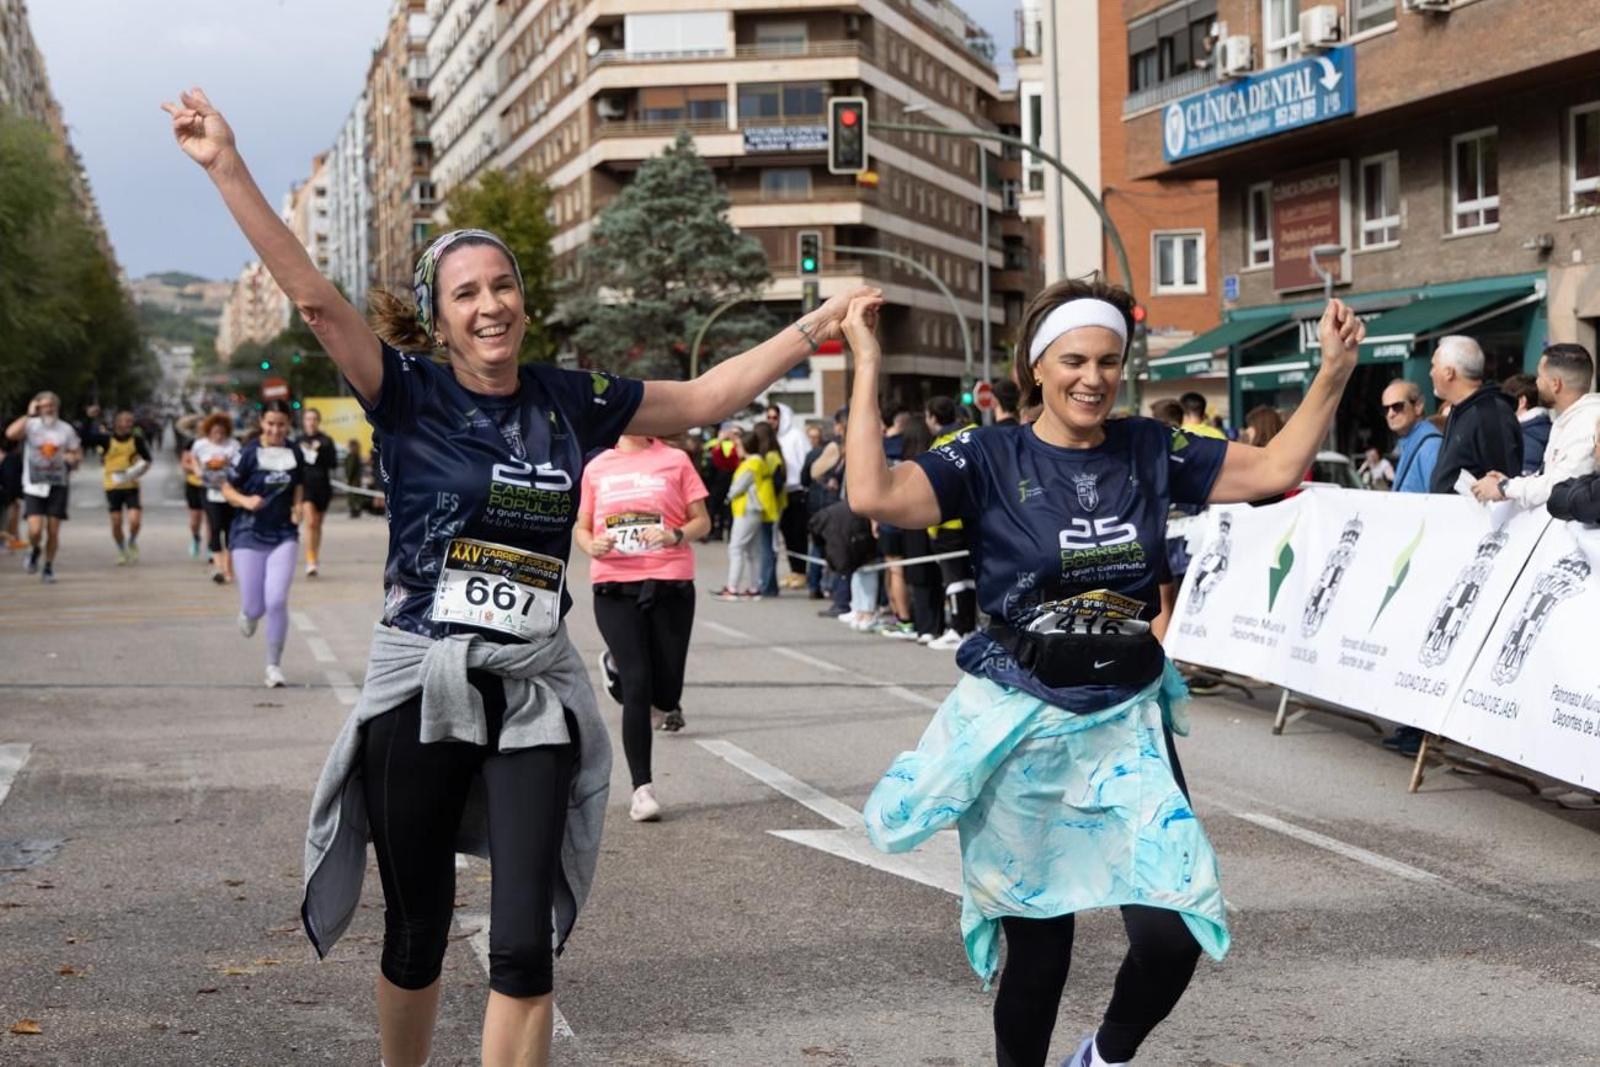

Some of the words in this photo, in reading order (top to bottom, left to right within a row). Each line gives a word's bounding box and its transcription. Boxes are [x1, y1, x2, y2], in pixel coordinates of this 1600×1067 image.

[1186, 88, 1246, 131] CLÍNICA
[1248, 66, 1317, 115] DENTAL
[491, 455, 573, 492] 25
[436, 492, 461, 512] IES
[490, 482, 572, 503] CARRERA
[488, 494, 572, 515] POPULAR
[1059, 516, 1137, 549] 25
[452, 542, 483, 563] XXV
[483, 548, 525, 564] CARRERA
[1061, 541, 1143, 561] CARRERA
[1062, 550, 1145, 572] POPULAR
[465, 576, 536, 617] 667
[1552, 708, 1583, 733] Deportes
